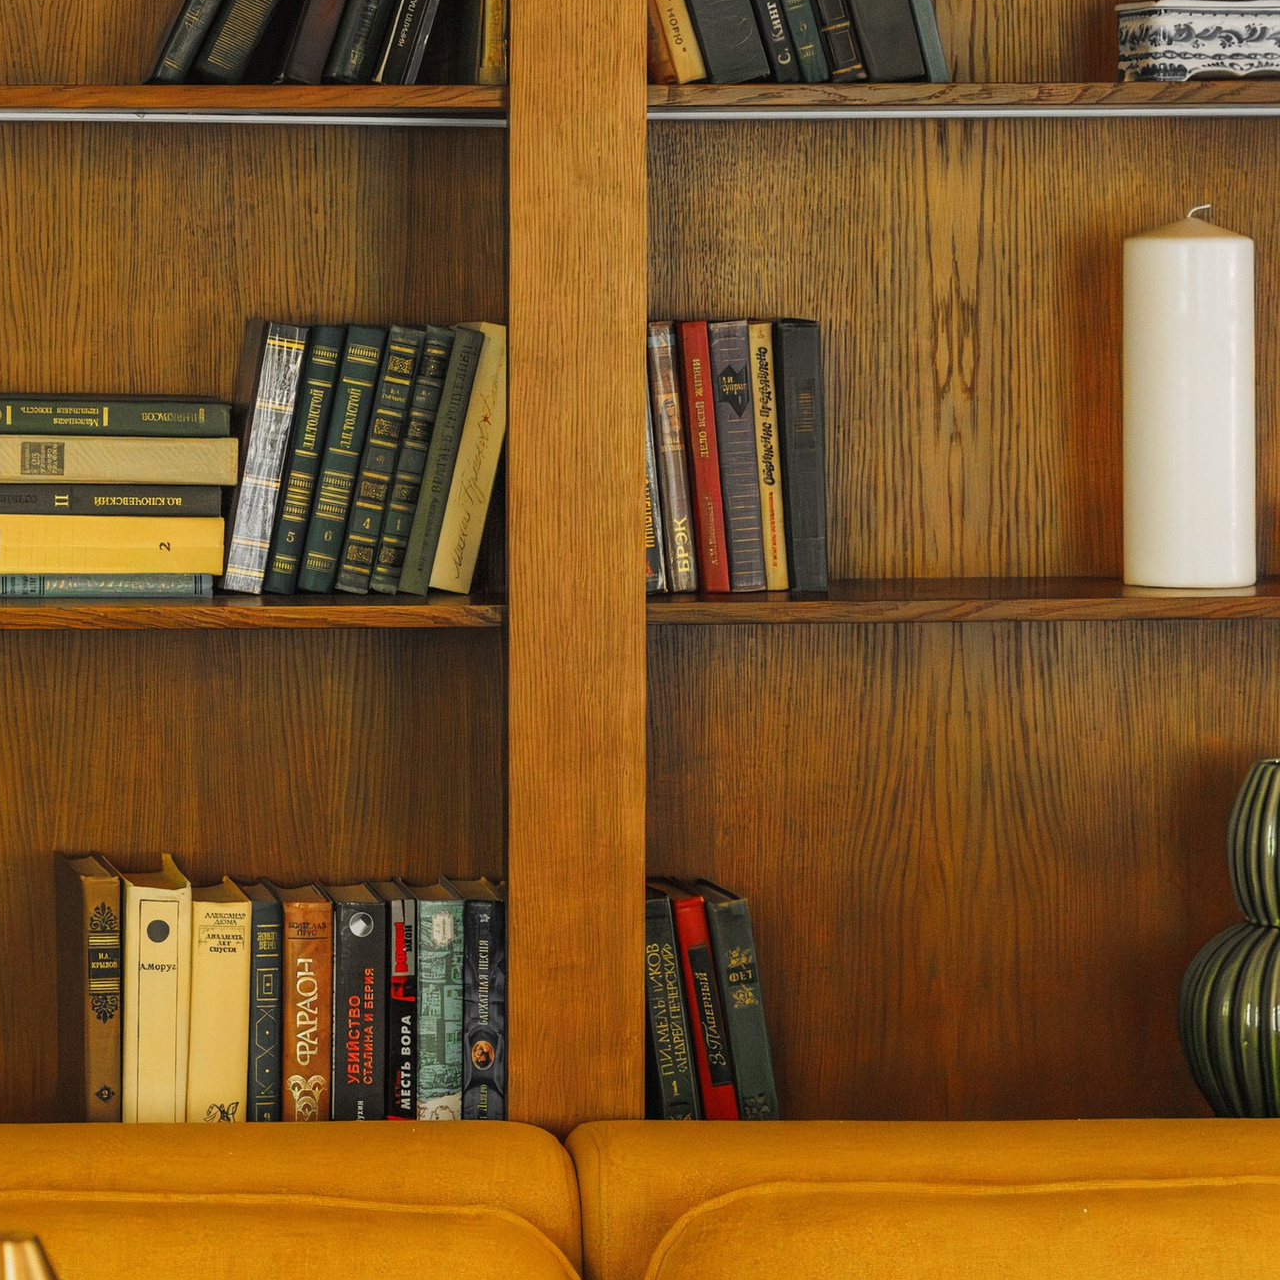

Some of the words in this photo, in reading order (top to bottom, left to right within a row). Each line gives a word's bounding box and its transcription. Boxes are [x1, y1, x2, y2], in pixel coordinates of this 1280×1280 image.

[397, 10, 413, 48] КИРИЛЛ
[778, 47, 792, 66] С.
[693, 358, 703, 397] ЖИЗНИ
[20, 404, 54, 414] повесть
[53, 415, 100, 427] Маленькая
[699, 431, 709, 459] ДЕЛО
[94, 494, 165, 507] КЛЮЧЕВСКИЙ
[287, 530, 296, 543] 5
[324, 528, 332, 541] 6
[158, 541, 171, 552] 2
[671, 516, 691, 573] БРЭК
[204, 911, 247, 921] АЛЕКСАНДР
[214, 918, 238, 927] ДЮМА
[288, 923, 328, 933] БОЛЕСЛАВ
[296, 929, 318, 938] ПРУС
[209, 946, 238, 955] СПУСТЯ
[477, 939, 489, 970] ПЕСНЯ
[91, 959, 118, 969] КРЫЛОВ
[728, 969, 754, 984] ФЕТ
[364, 968, 375, 1009] БЕРИЯ
[646, 943, 672, 1043] МЕЛЬИКОВ
[477, 973, 489, 1026] БАРХАТНАЯ
[296, 957, 314, 1067] ФАРАОН
[364, 1013, 374, 1022] И
[347, 995, 361, 1085] УБИЙСТВО
[401, 1014, 412, 1060] ВОРА
[363, 1026, 374, 1086] СТАЛИНА
[401, 1063, 412, 1110] МЕСТЬ
[357, 1100, 365, 1122] ухин
